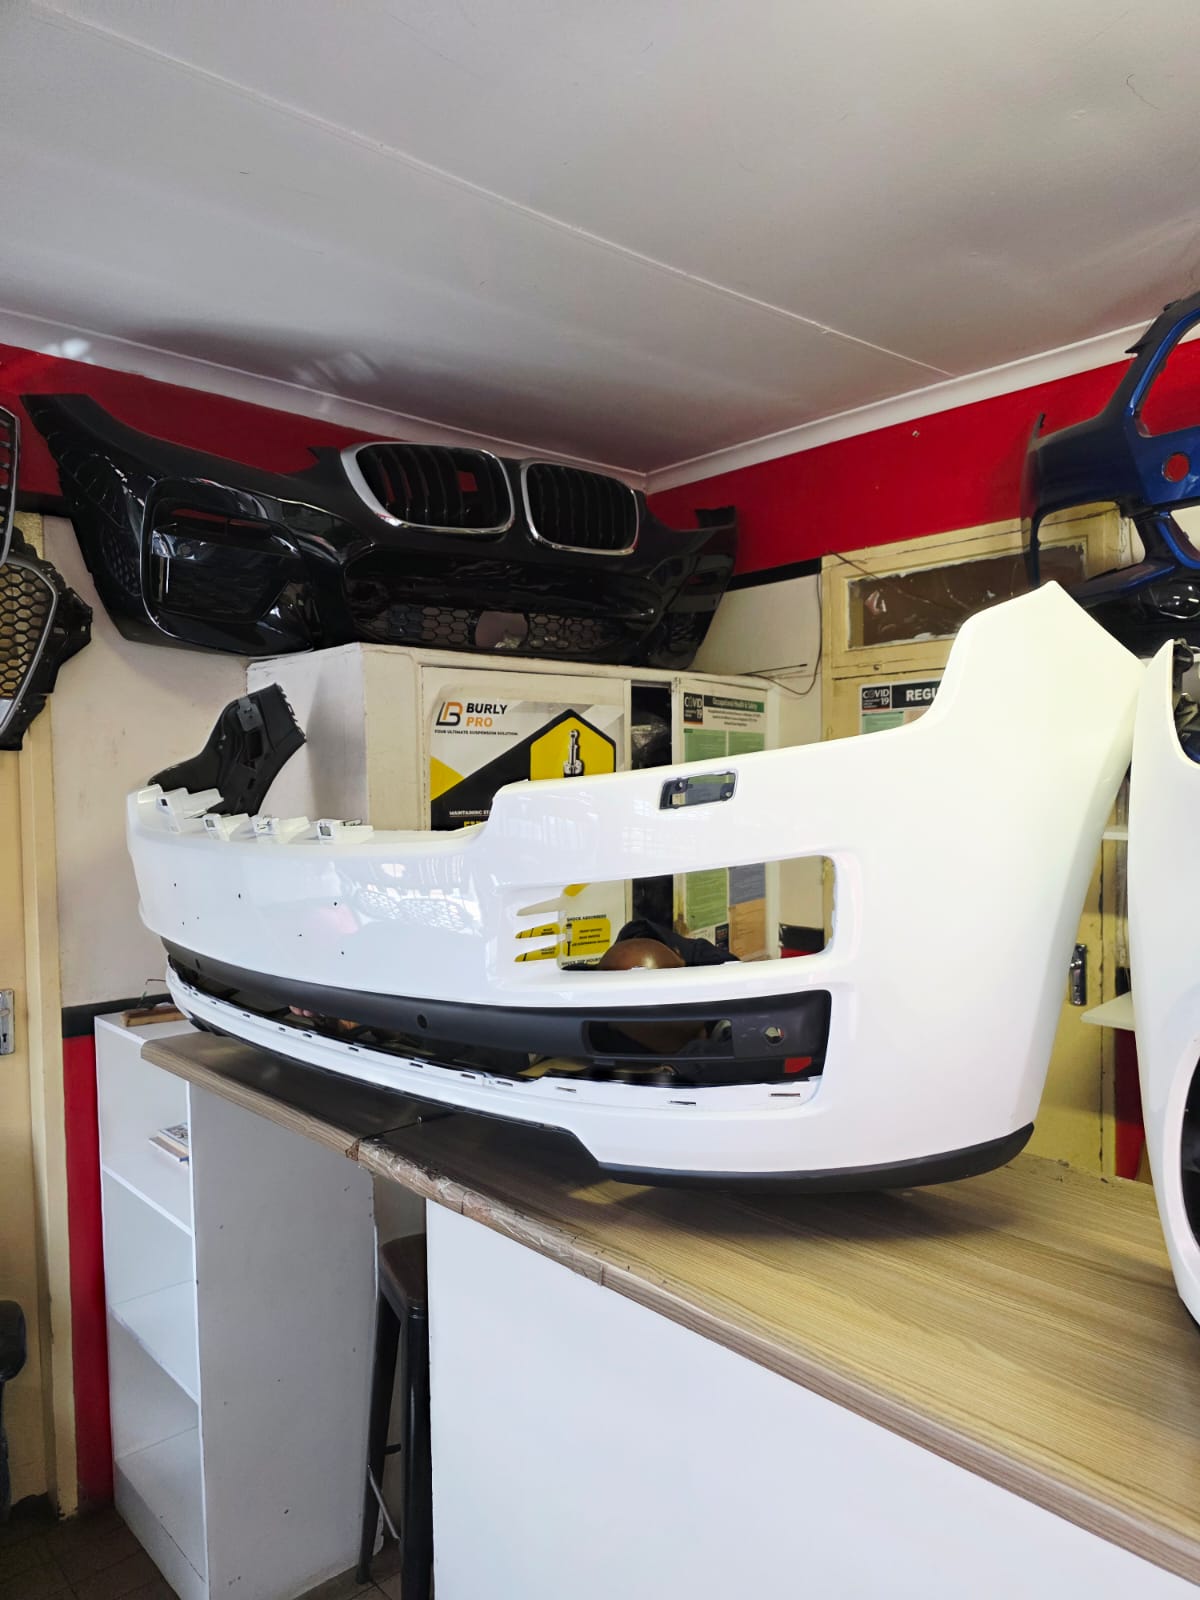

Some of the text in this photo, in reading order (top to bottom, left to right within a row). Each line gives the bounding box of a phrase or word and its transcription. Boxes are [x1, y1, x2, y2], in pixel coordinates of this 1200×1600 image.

[862, 688, 890, 699] COVID
[880, 697, 890, 705] 19
[466, 702, 508, 715] BURLY
[466, 716, 493, 727] PRO
